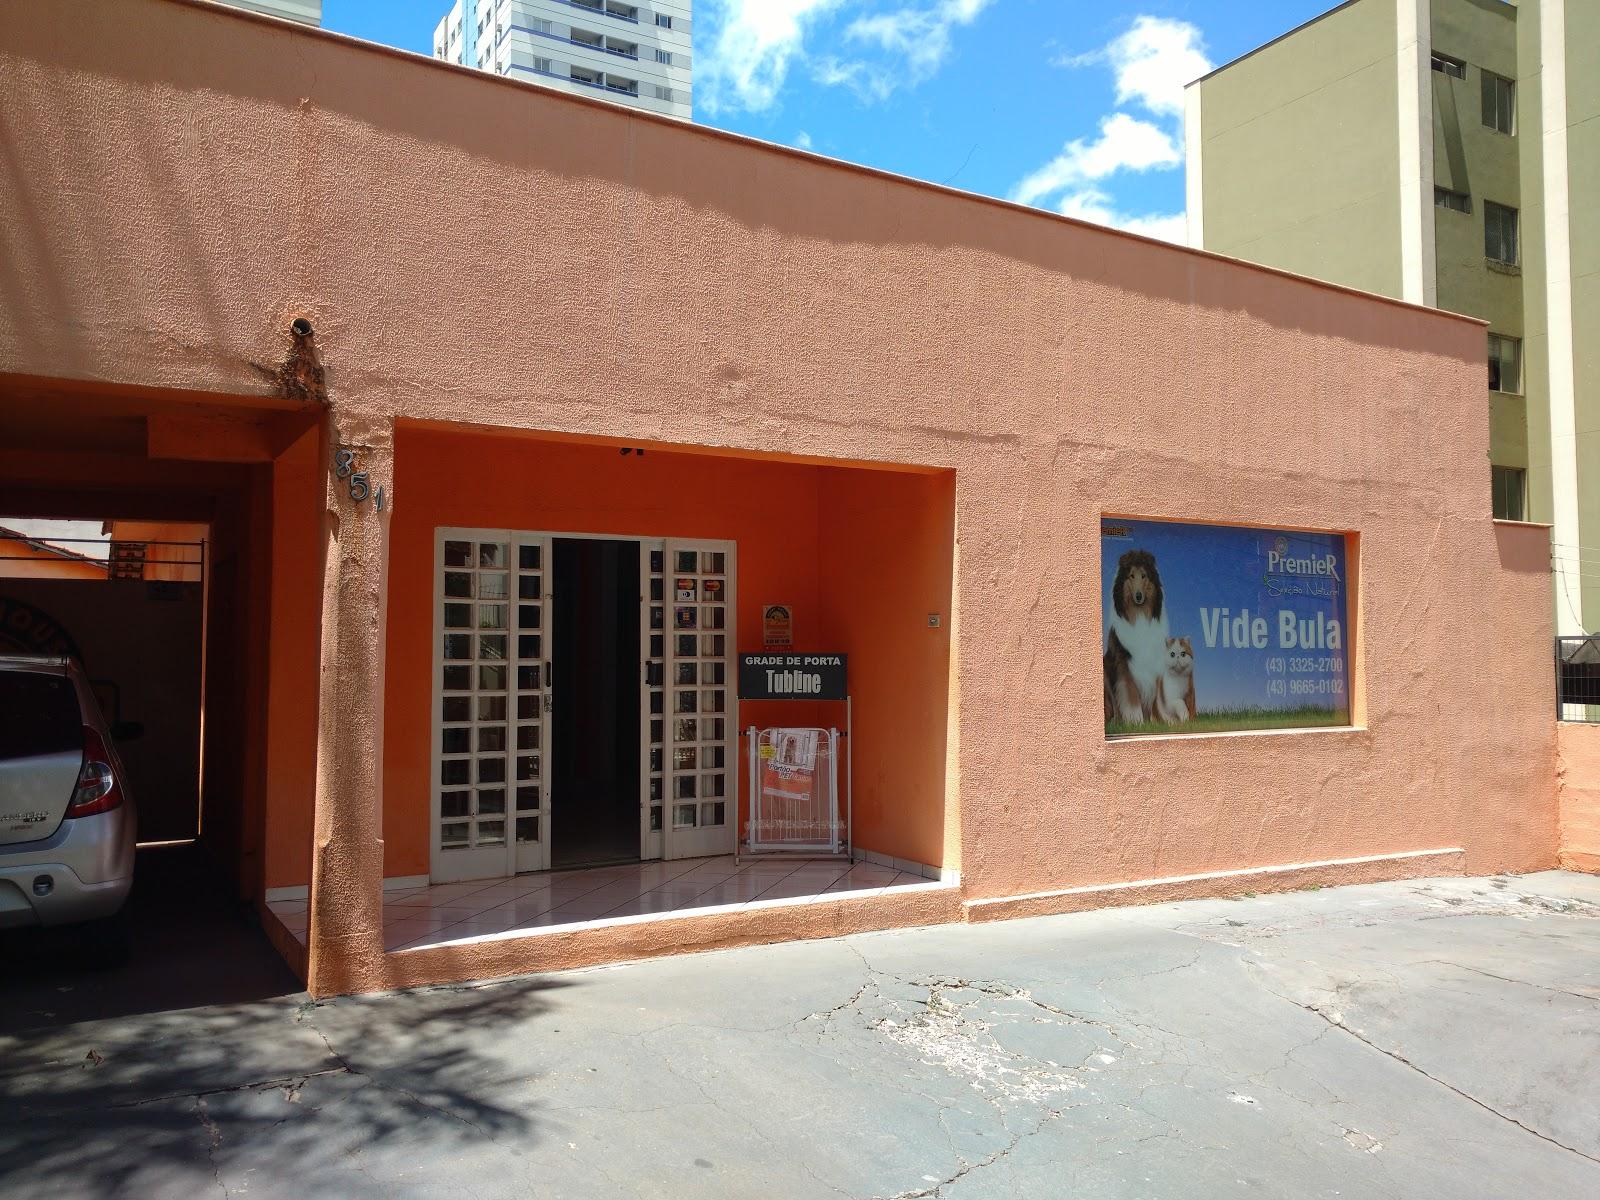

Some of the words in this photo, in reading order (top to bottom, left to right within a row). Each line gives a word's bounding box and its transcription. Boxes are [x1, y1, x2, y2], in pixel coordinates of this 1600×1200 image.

[335, 449, 385, 512] 851
[1199, 607, 1269, 649] Vide
[1279, 609, 1342, 650] Bula
[745, 656, 784, 666] GRADE
[786, 656, 801, 666] DE
[804, 656, 841, 666] PORTA
[1265, 657, 1286, 676] (43)
[1289, 657, 1343, 673] 3325-2700
[1266, 679, 1287, 698] (43)
[1290, 679, 1344, 695] 9665-0102
